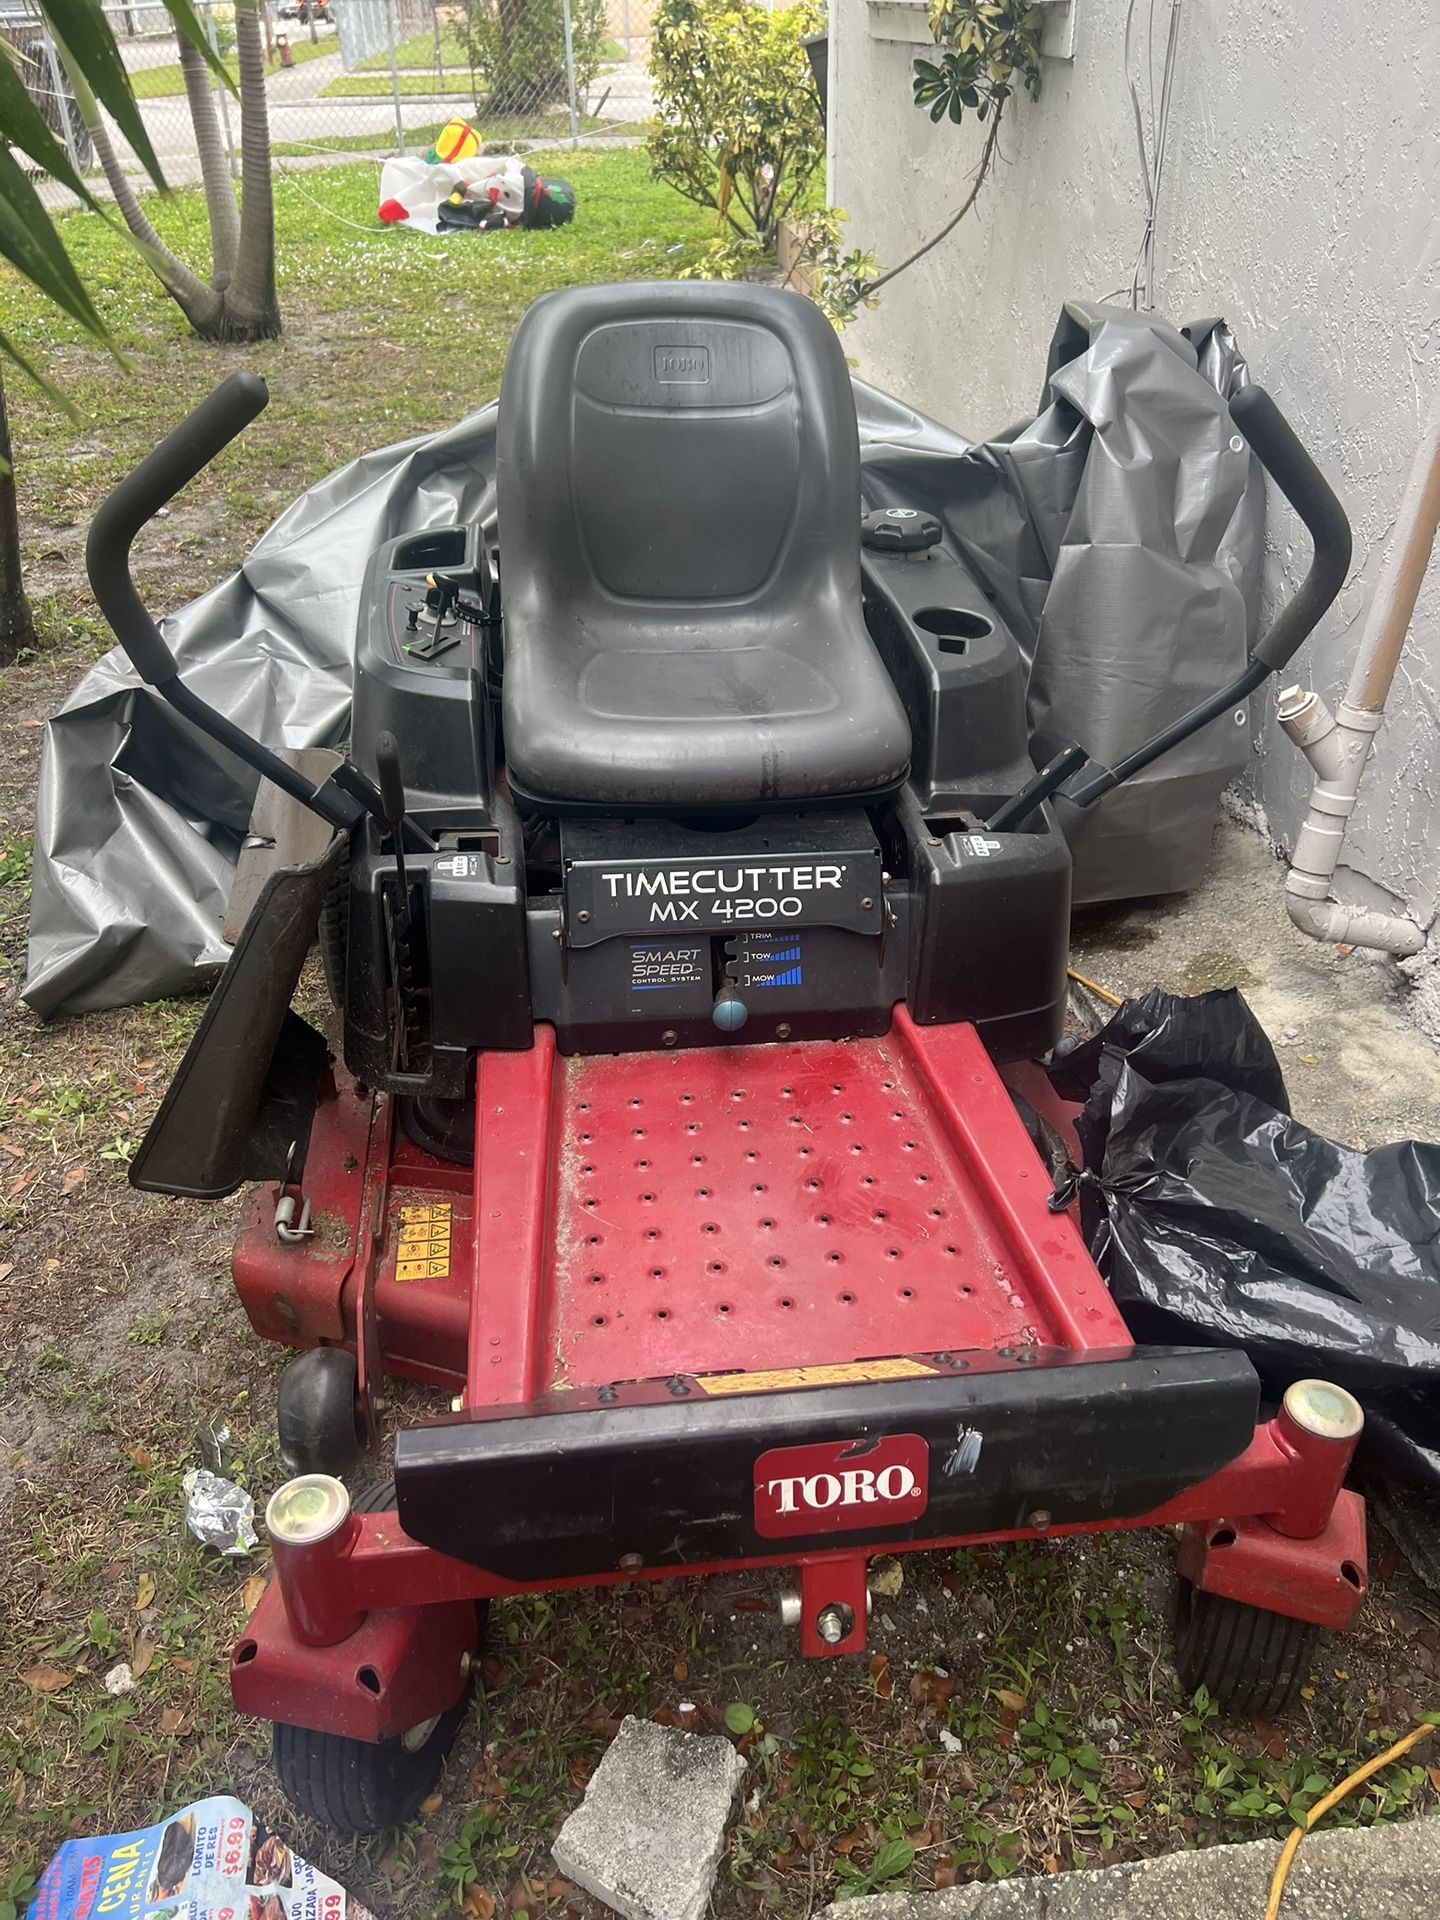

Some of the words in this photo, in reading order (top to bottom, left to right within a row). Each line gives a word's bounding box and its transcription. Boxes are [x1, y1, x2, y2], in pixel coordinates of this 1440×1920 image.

[602, 865, 846, 897] TIMECUTTER
[650, 900, 700, 922] MX
[711, 896, 803, 919] 4200
[632, 949, 701, 963] SMART
[632, 963, 695, 977] SPEED
[192, 1826, 207, 1876] LOMITO
[207, 1826, 218, 1849] RES
[222, 1817, 245, 1875] $6.99
[97, 1839, 146, 1913] CENA
[204, 1853, 215, 1868] DE
[74, 1856, 102, 1920] RATIS
[305, 1888, 317, 1920] ZADA
